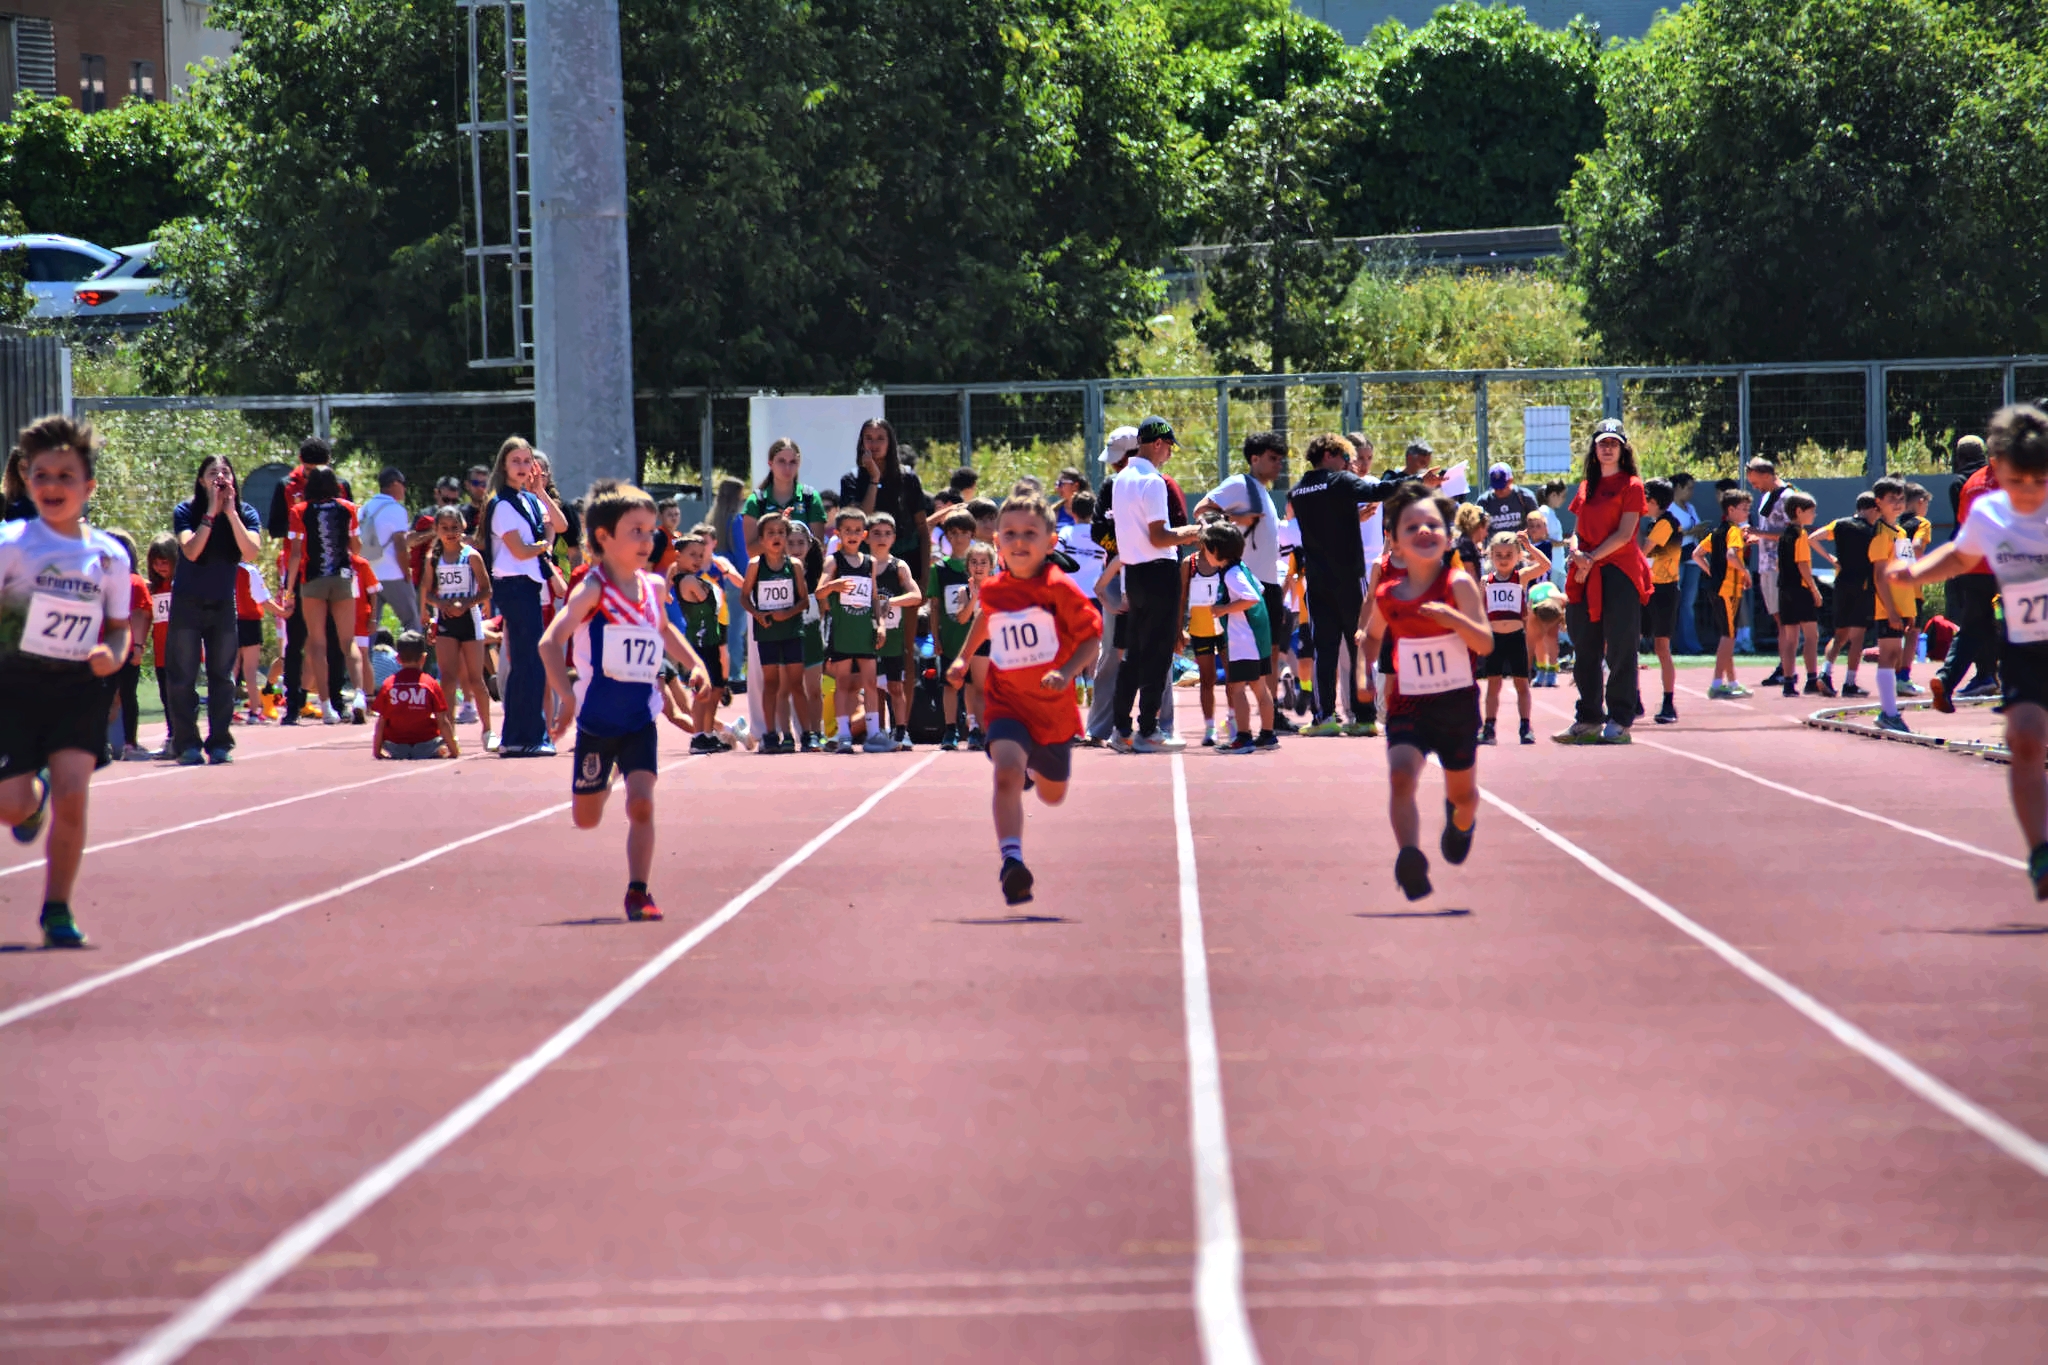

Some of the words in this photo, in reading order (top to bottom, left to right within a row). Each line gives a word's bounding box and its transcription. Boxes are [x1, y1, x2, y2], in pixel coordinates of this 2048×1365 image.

[764, 586, 789, 601] 700
[1493, 590, 1514, 602] 106
[42, 611, 92, 642] 277
[1001, 623, 1038, 652] 110
[622, 638, 656, 666] 172
[1413, 650, 1447, 677] 111
